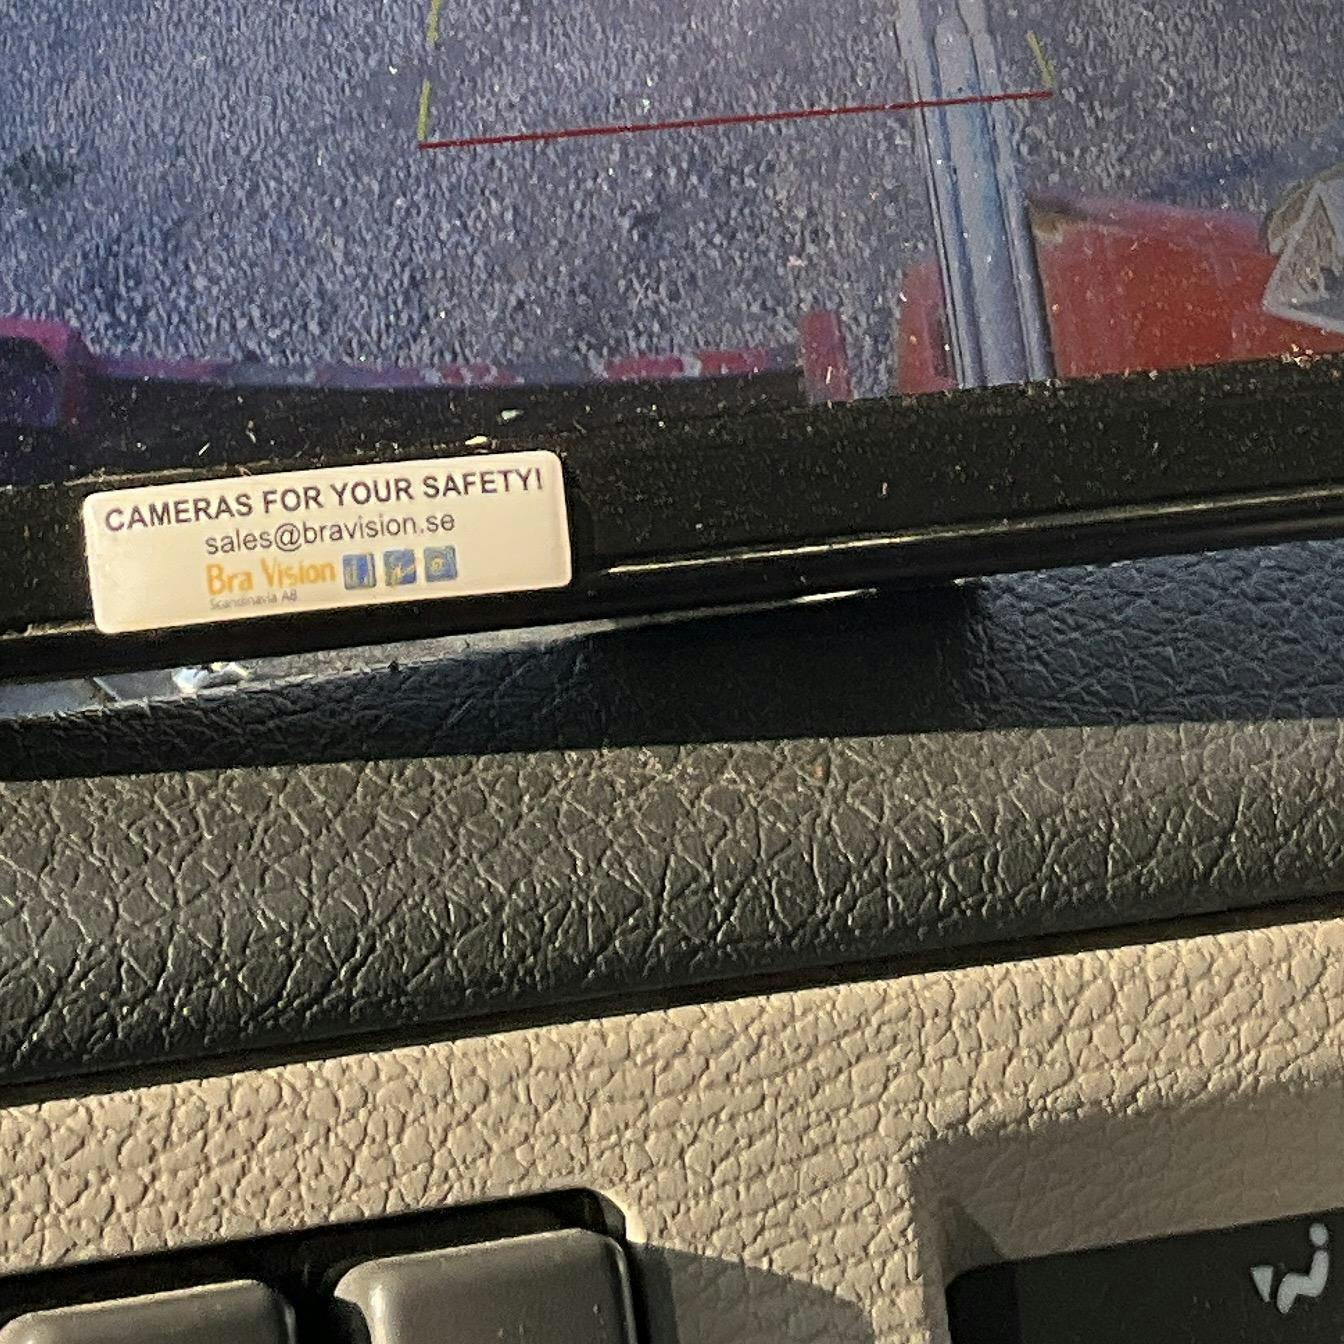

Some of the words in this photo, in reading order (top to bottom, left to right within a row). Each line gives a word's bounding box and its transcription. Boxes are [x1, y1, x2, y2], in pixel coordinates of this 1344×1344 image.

[106, 493, 253, 531] CAMERAS
[263, 486, 324, 513] FOR
[330, 478, 414, 506] YOUR
[205, 513, 455, 555] sales@bravision.se
[206, 563, 254, 596] Bra
[260, 557, 337, 590] Vision
